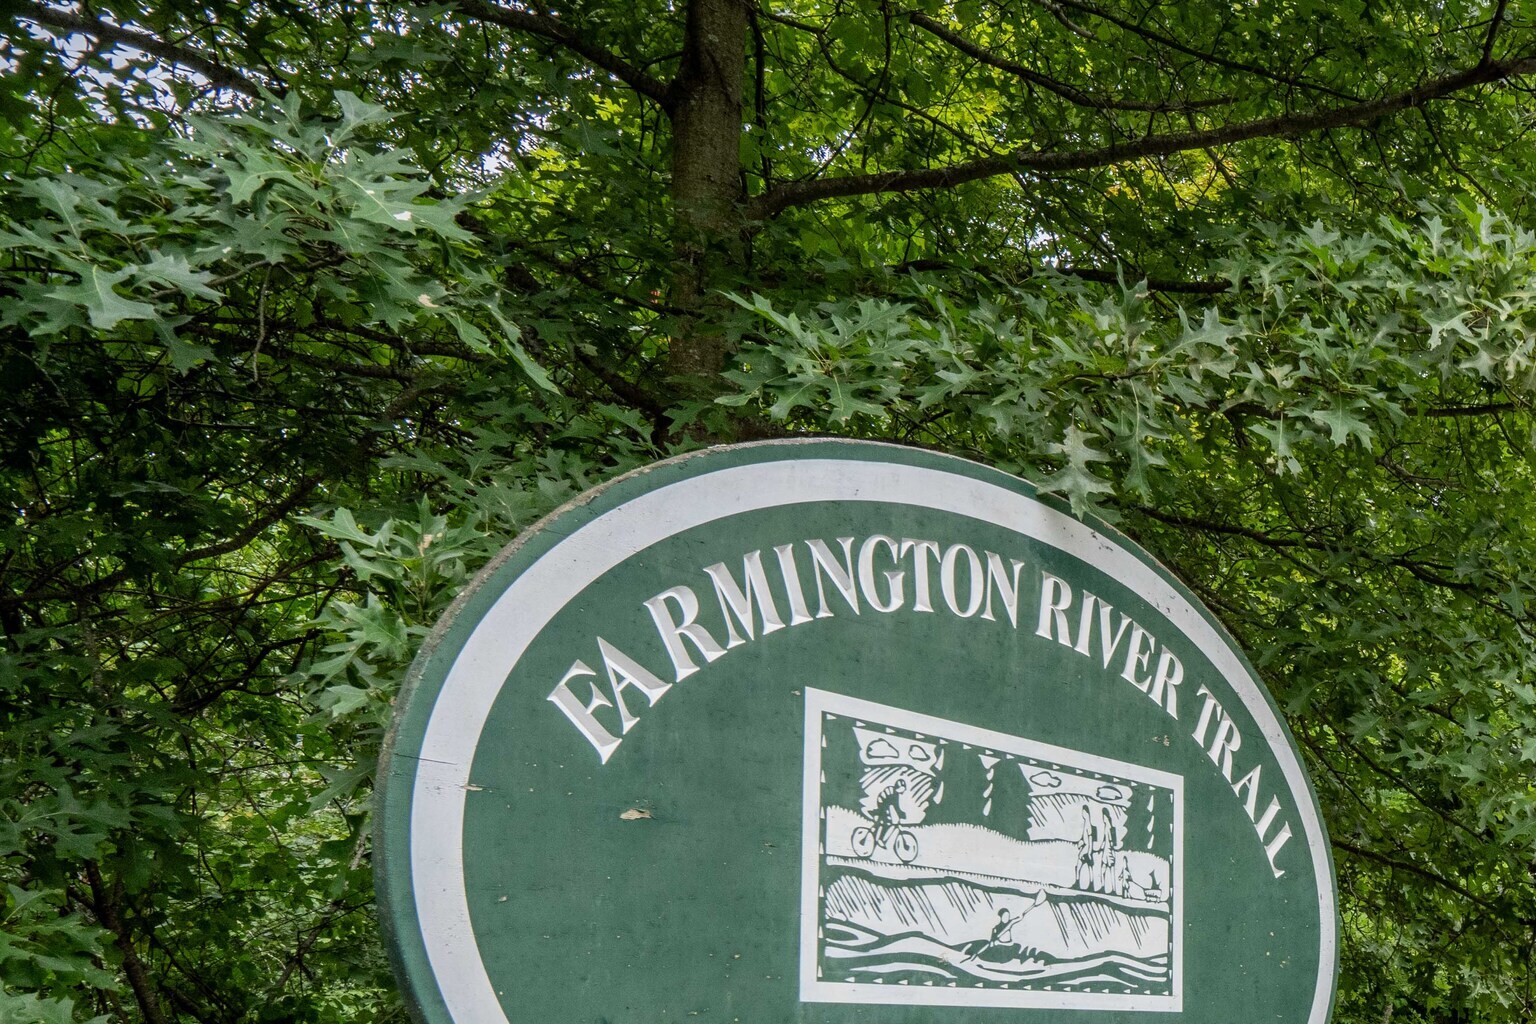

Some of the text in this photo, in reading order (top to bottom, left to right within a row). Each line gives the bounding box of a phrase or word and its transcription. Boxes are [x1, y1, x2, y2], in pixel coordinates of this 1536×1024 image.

[546, 534, 1293, 880] FARMINGTON RIVER TRAIL
